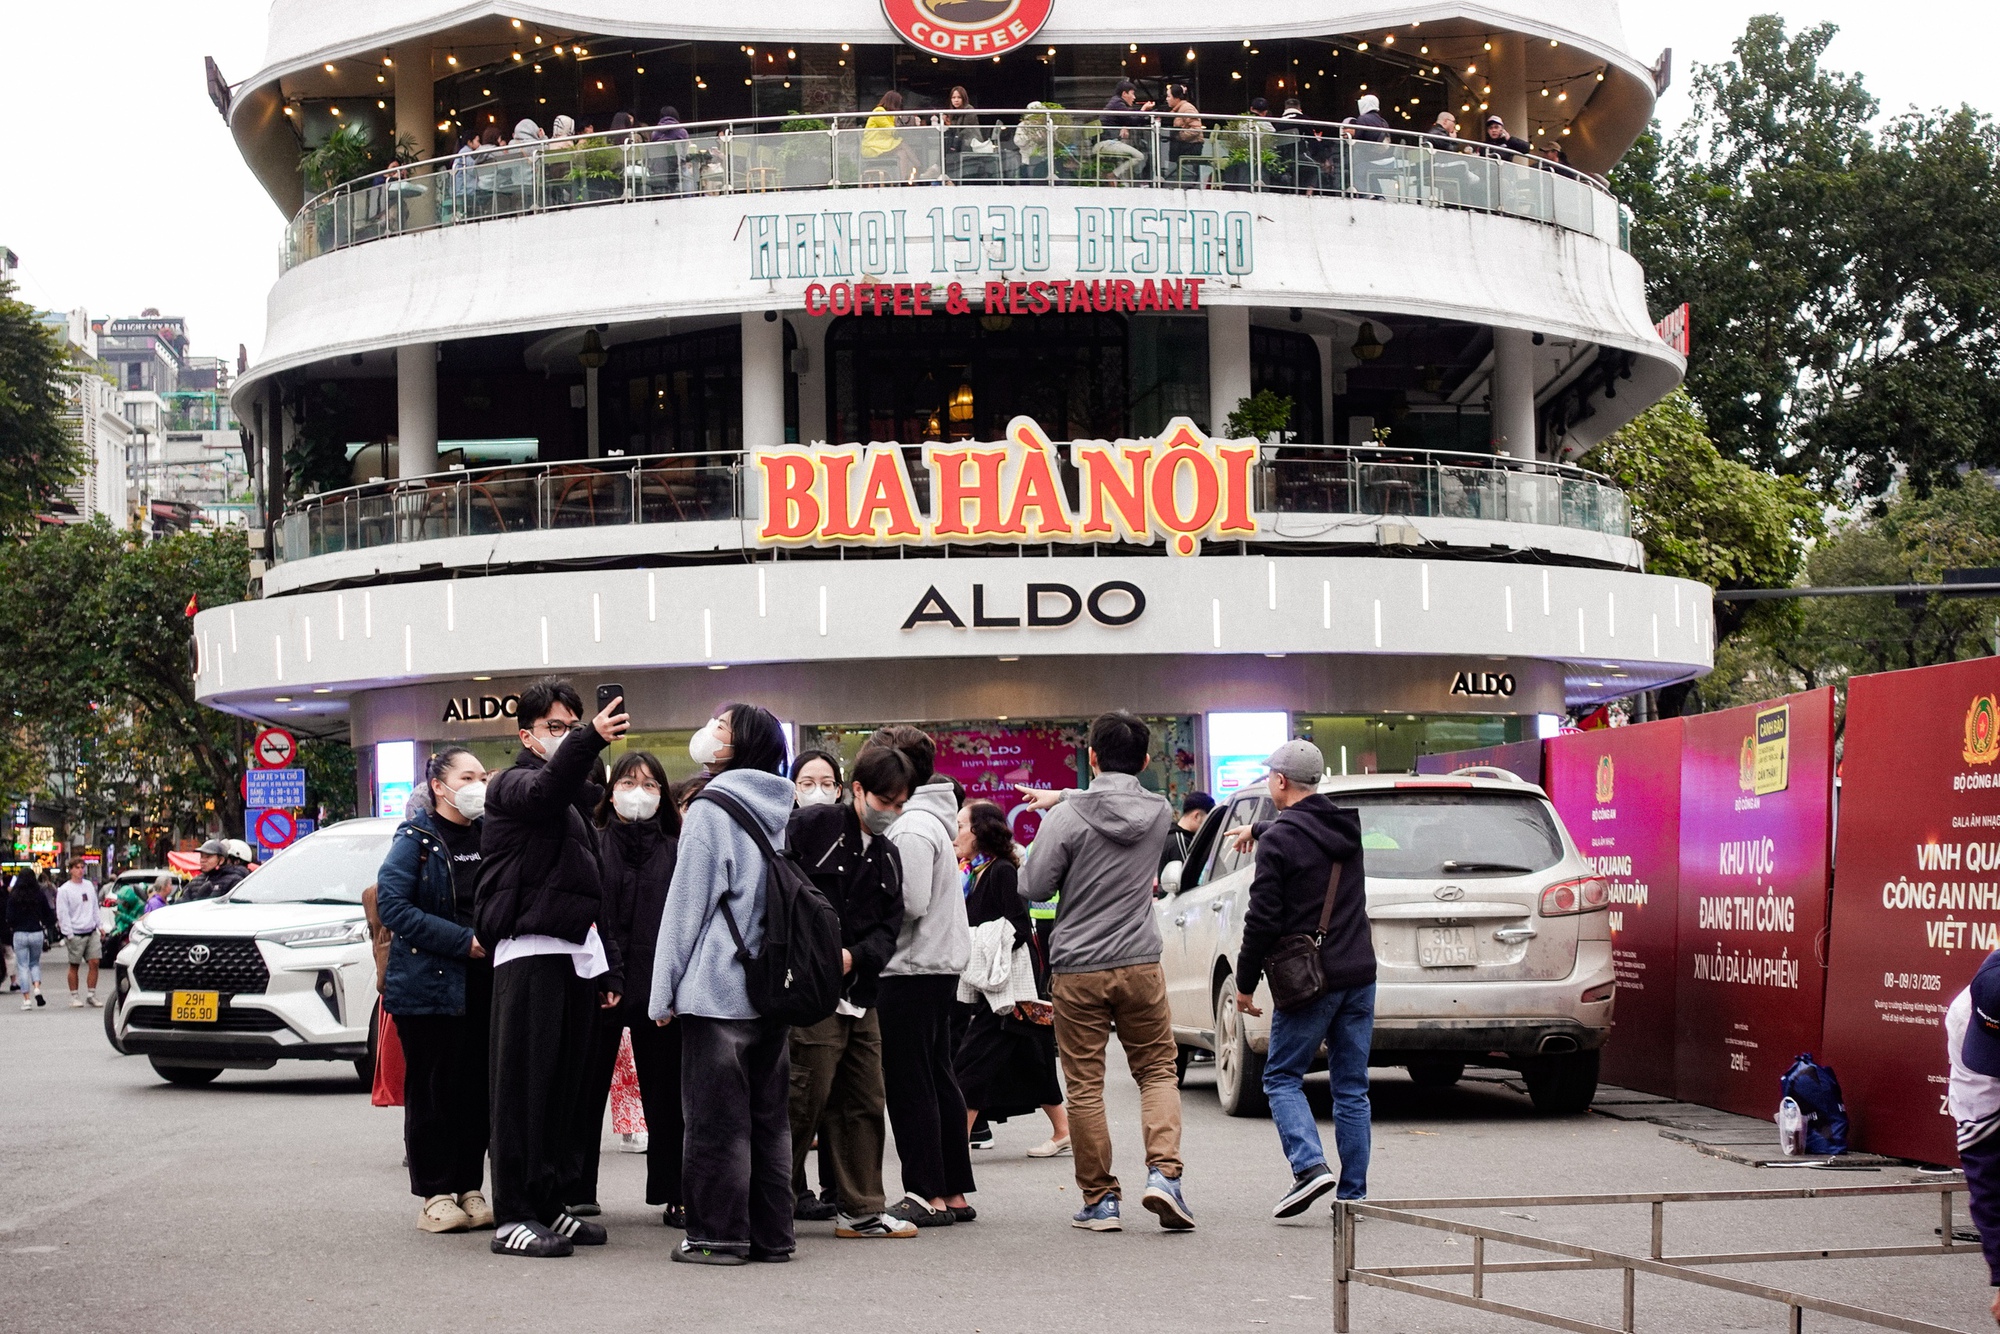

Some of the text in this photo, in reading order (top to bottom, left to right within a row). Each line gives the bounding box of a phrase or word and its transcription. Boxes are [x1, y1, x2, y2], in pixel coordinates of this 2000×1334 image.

[911, 18, 1028, 51] COFFEE
[748, 206, 1255, 280] HANOI 1930 BISTRO
[804, 277, 1206, 317] COFFEE & RESTAURANT
[757, 451, 922, 541] BIA
[901, 580, 1146, 630] ALDO
[1450, 671, 1517, 696] ALDO
[442, 694, 520, 723] ALDO
[1953, 772, 1965, 793] BỘ
[1967, 772, 1991, 789] CÔNG
[1952, 816, 1969, 828] GALA
[1970, 813, 1981, 827] ÂM
[1598, 855, 1632, 876] QUANG
[1719, 835, 1774, 886] KHU VỰC
[1917, 843, 1961, 871] VINH
[1627, 879, 1648, 904] DÂN
[1882, 875, 2000, 910] CÔNG AN NH
[1699, 885, 1794, 932] ĐANG THI CÔNG
[1432, 928, 1463, 945] 30A
[1926, 914, 1967, 956] VIỆT
[1694, 941, 1798, 989] XIN LỖI ĐÃ LÀM PHIỀN!
[176, 1007, 212, 1020] 966.90
[185, 993, 205, 1006] 29H
